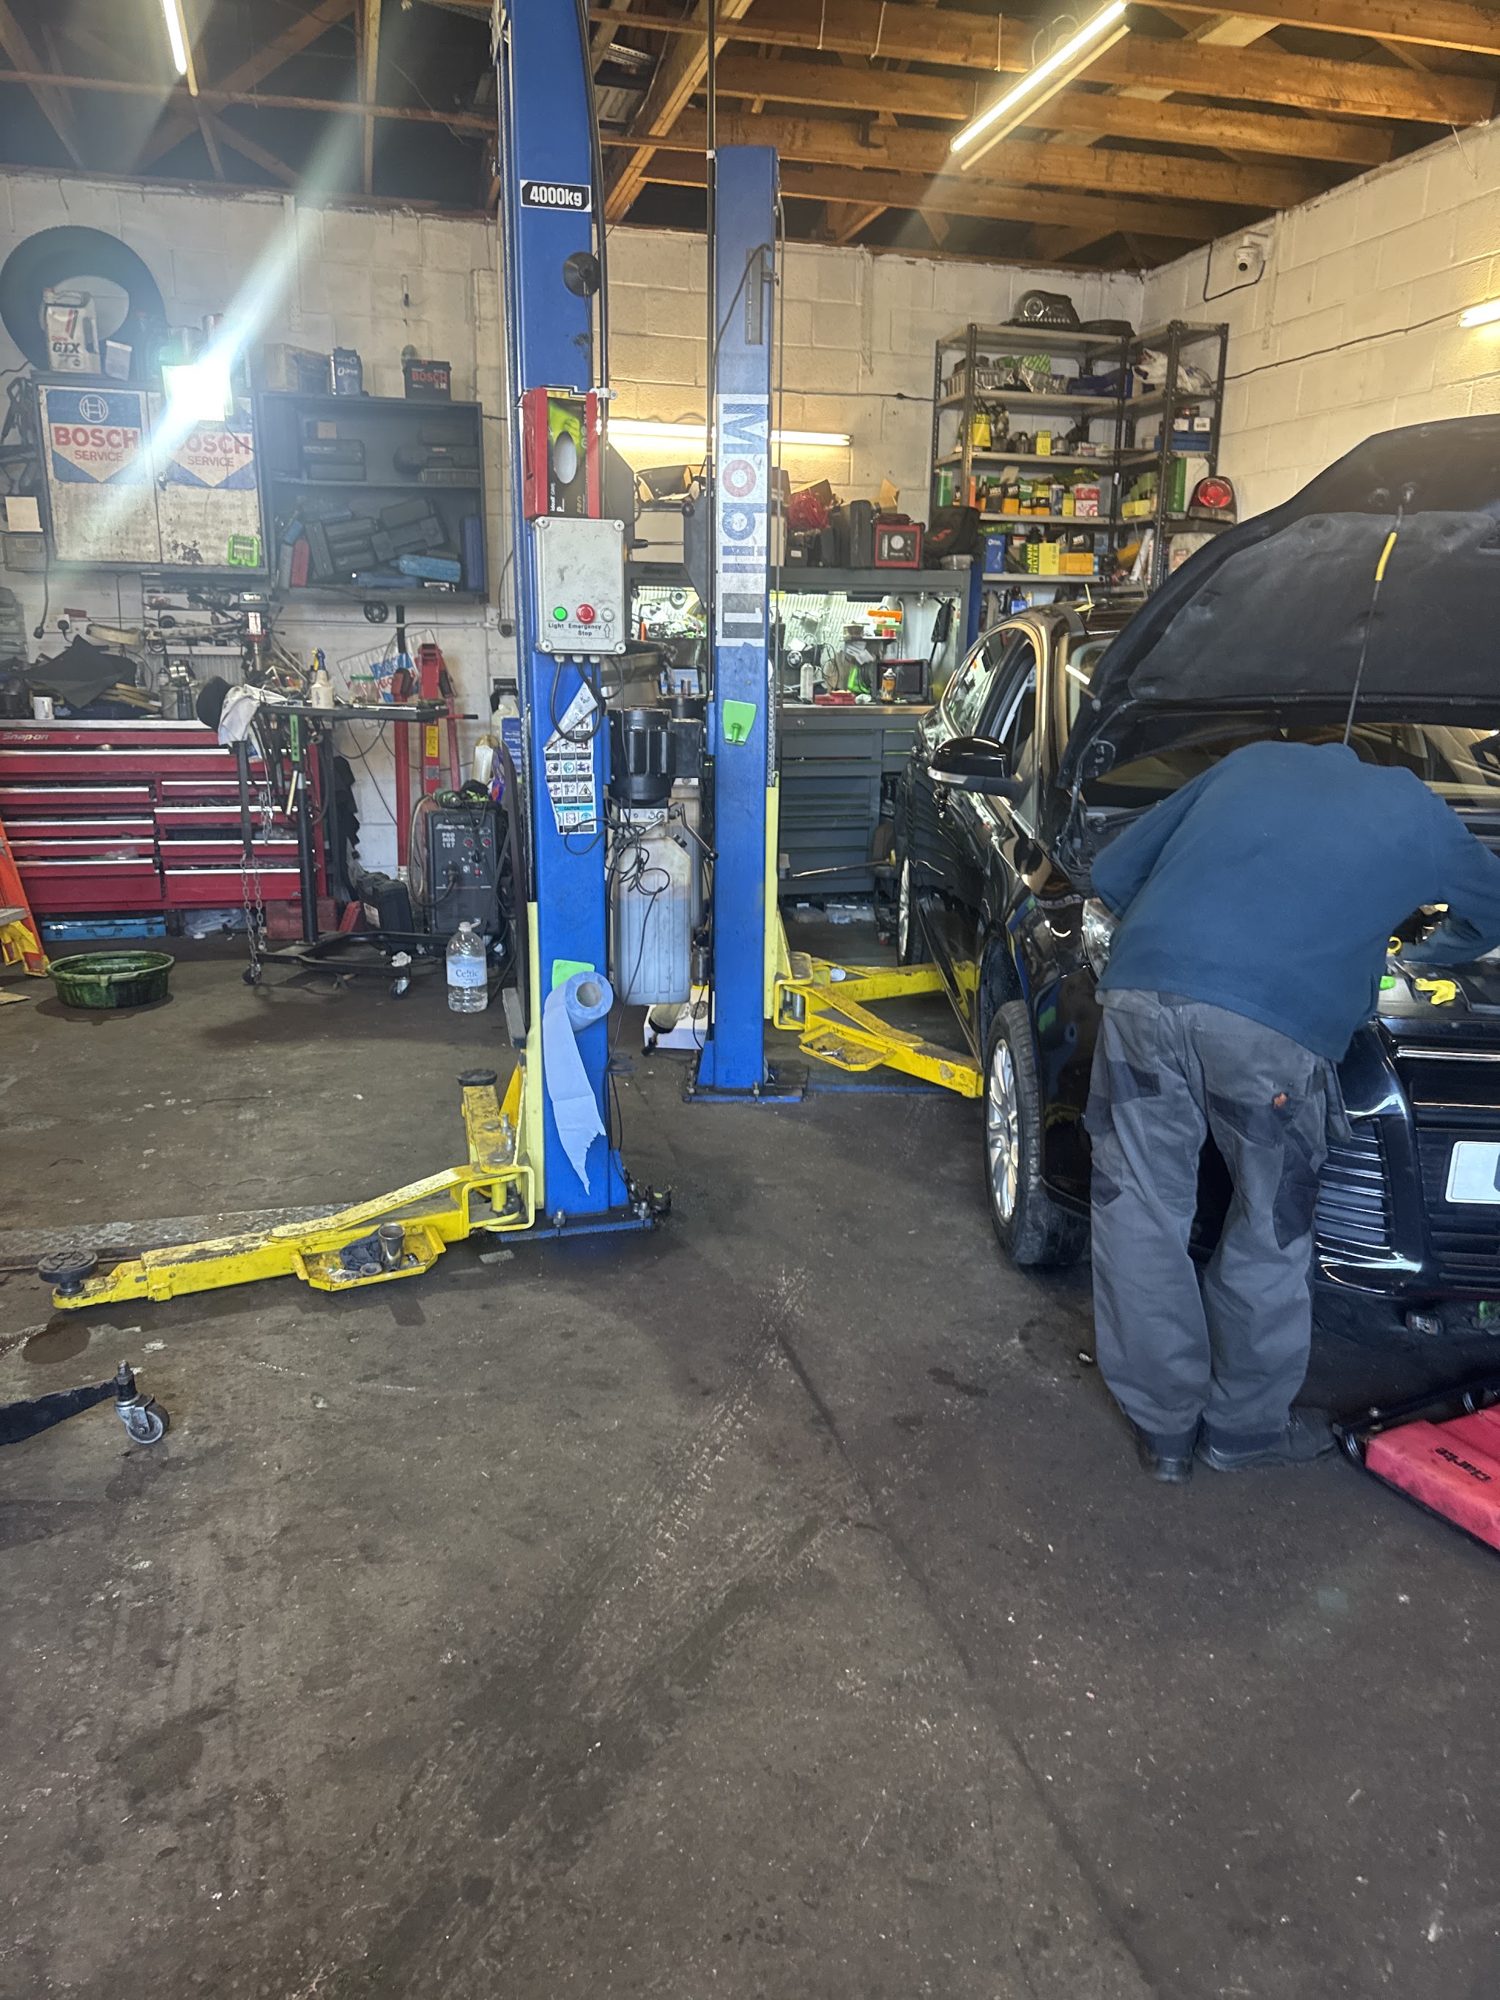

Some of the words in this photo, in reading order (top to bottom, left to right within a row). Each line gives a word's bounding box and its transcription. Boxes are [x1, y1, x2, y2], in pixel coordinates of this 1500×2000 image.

[529, 185, 583, 207] 4000kg
[52, 341, 80, 354] GTX
[411, 371, 448, 384] BOSCH
[53, 426, 139, 450] BOSCH
[74, 450, 124, 462] SERVICE
[187, 455, 235, 468] SERVICE
[721, 403, 767, 573] Mobil
[2, 731, 49, 742] Snap-on
[455, 968, 480, 978] Celtic
